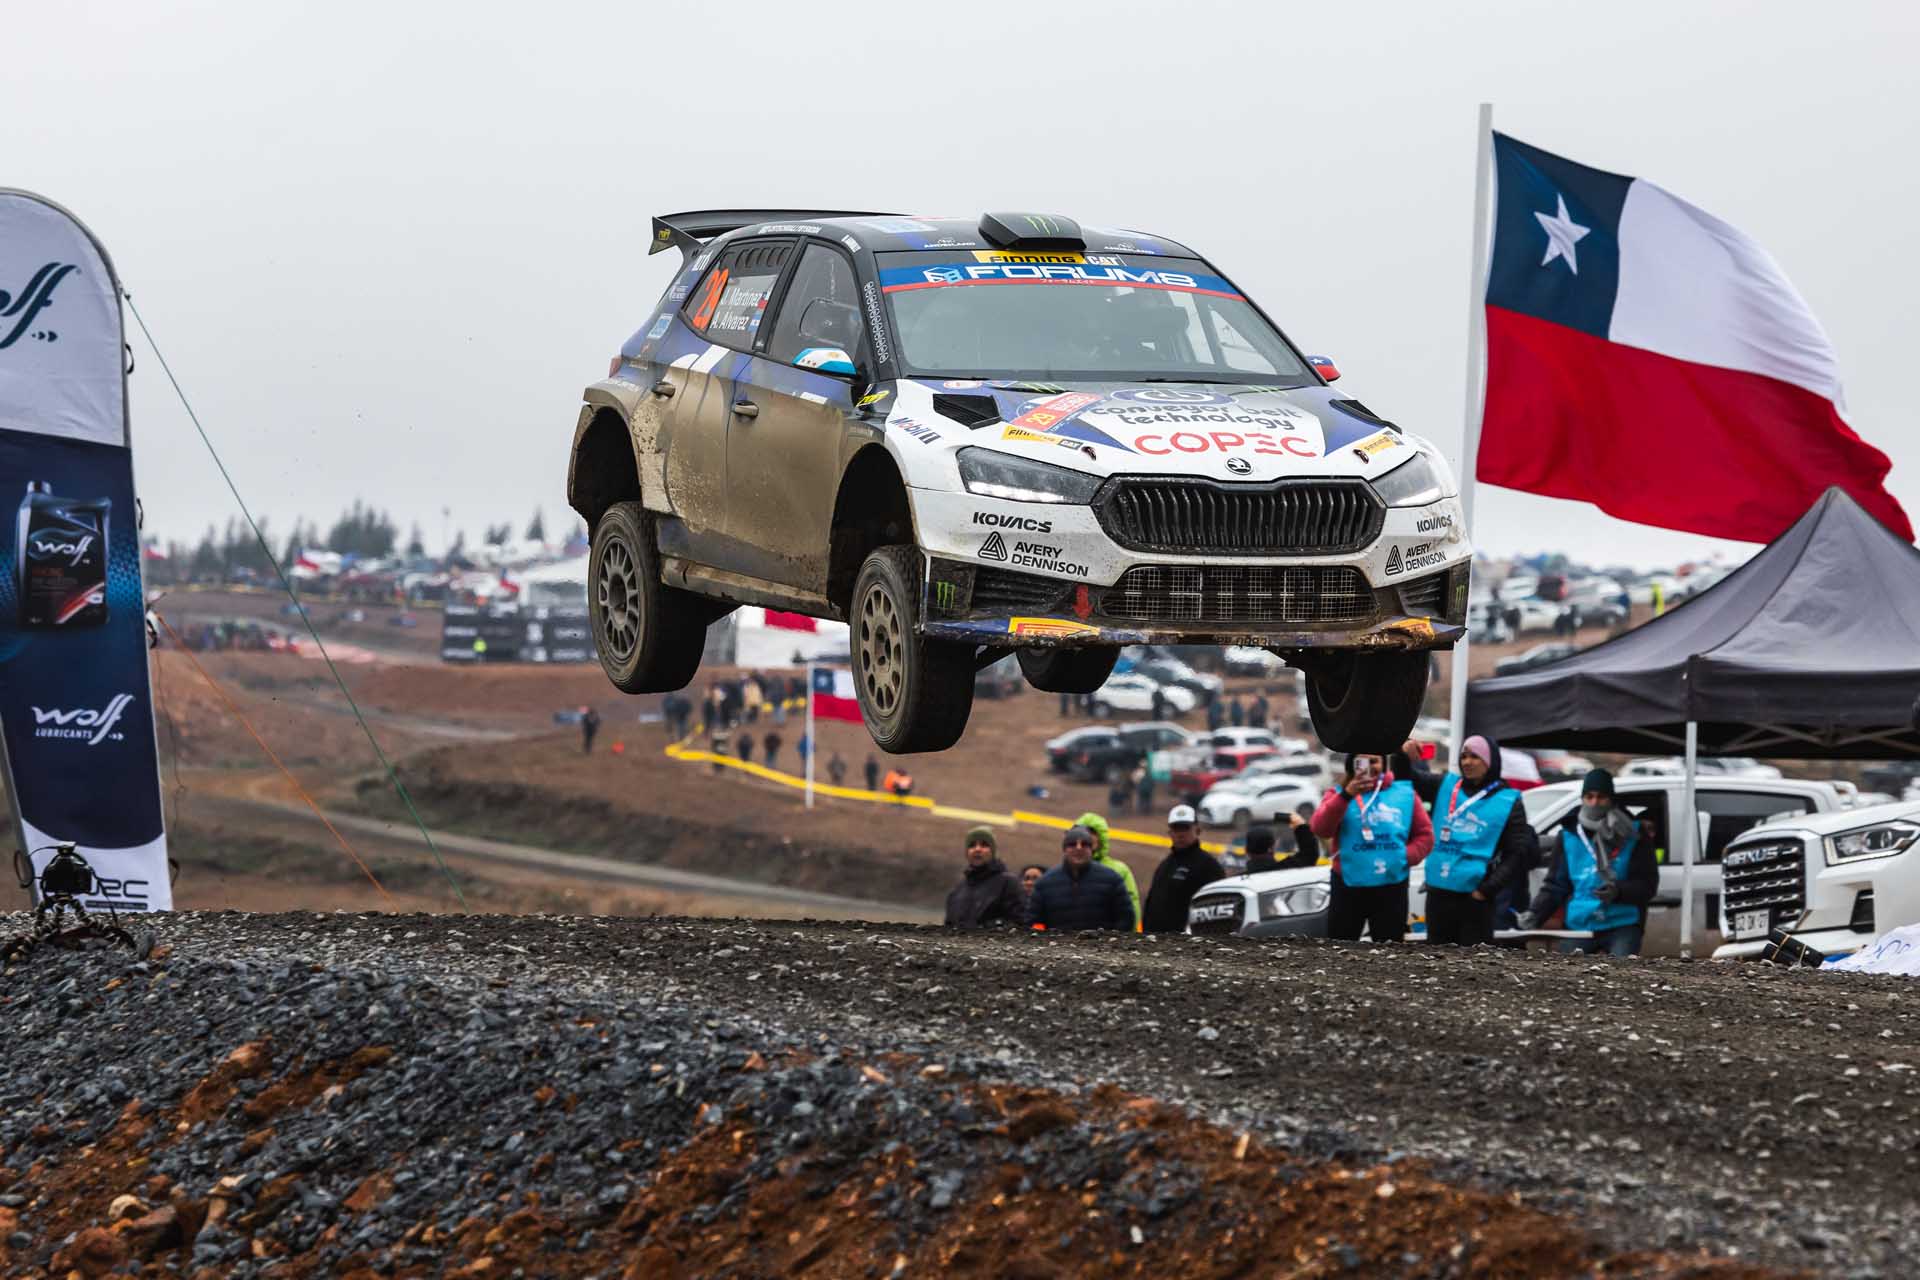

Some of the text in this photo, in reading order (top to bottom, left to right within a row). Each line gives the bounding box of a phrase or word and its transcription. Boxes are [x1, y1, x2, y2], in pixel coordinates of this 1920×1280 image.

[1087, 255, 1119, 266] CAT
[965, 265, 1197, 288] FORUM8
[1092, 403, 1229, 416] conveyor
[1237, 404, 1302, 418] belt
[888, 416, 930, 438] Mobil
[1118, 411, 1296, 431] technology
[1134, 431, 1317, 457] COPEC
[972, 511, 1053, 534] KOVACS
[1416, 514, 1453, 533] KOVACS
[1014, 541, 1063, 559] AVERY
[1405, 542, 1432, 559] AVERY
[1011, 553, 1089, 577] DENNISON
[1405, 551, 1447, 572] DENNISON
[36, 728, 93, 740] LUBRICANTS
[1727, 845, 1778, 867] MAXUS
